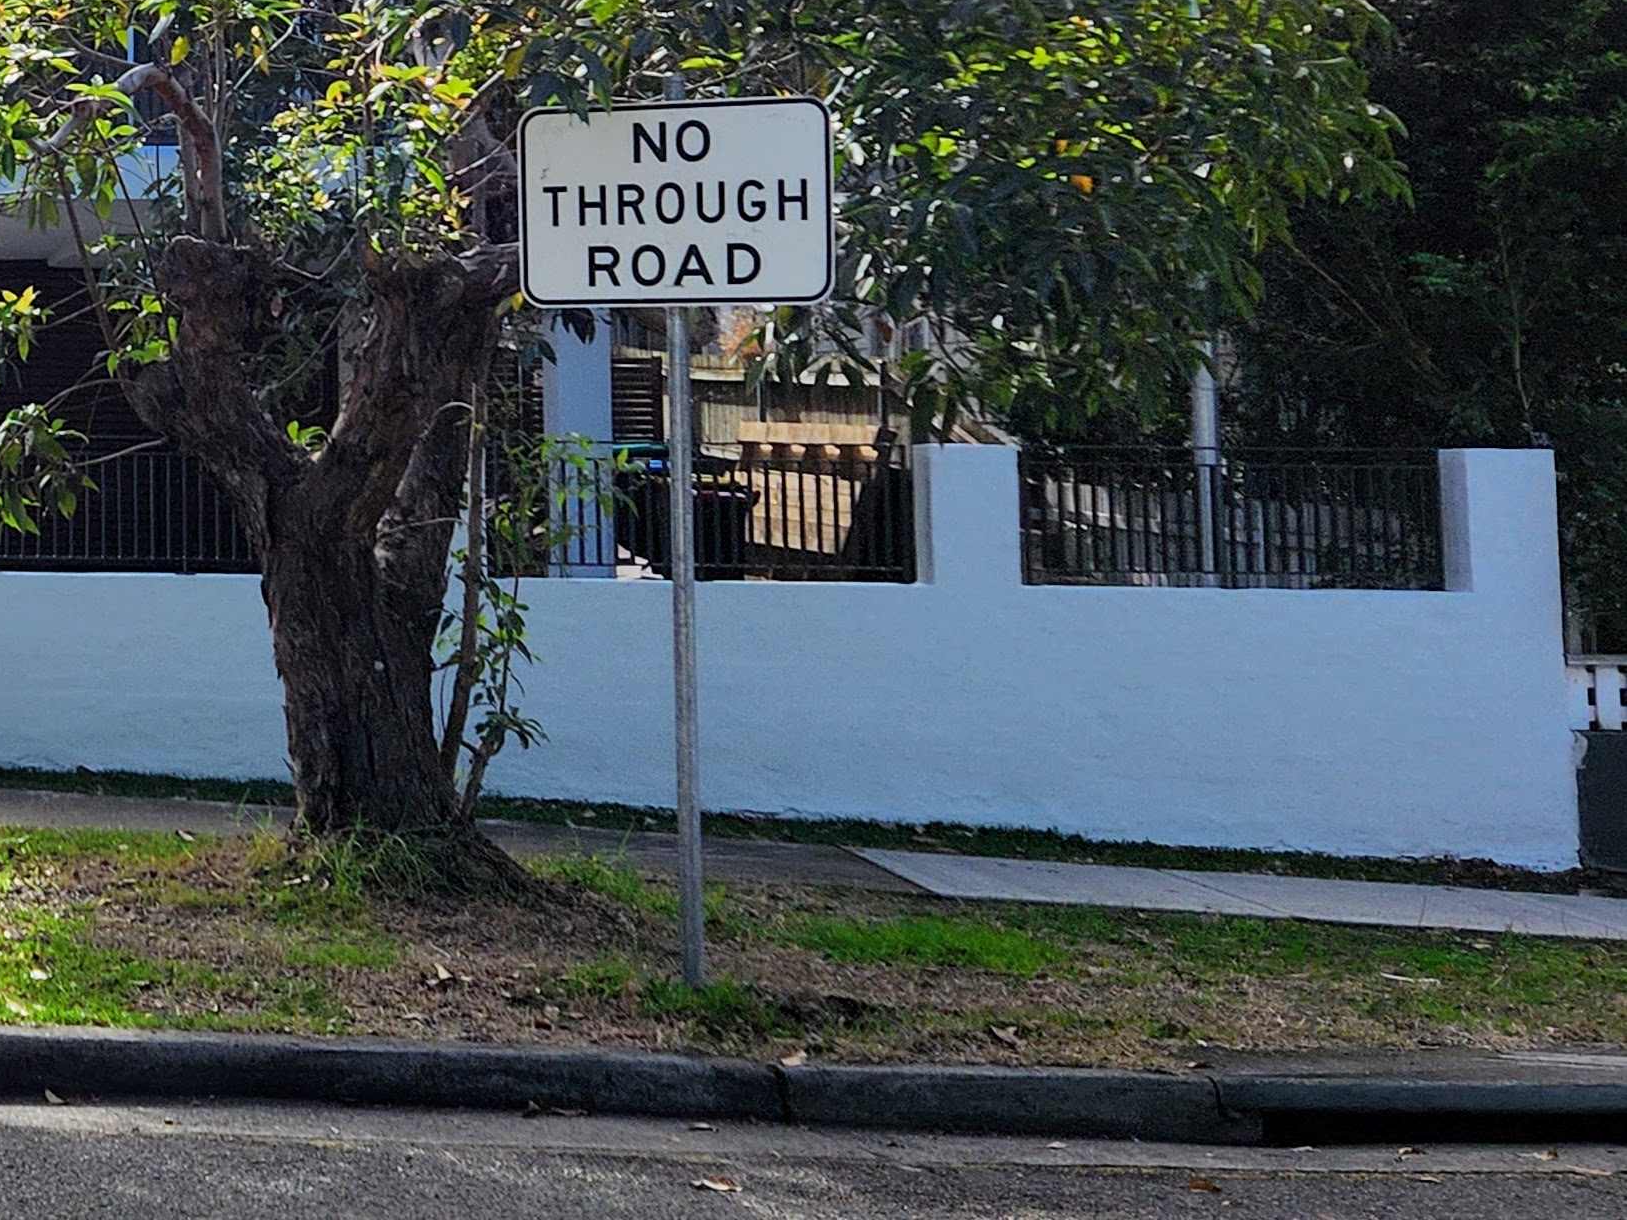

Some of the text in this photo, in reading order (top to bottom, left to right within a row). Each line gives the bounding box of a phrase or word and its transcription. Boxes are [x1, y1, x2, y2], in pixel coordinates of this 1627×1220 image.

[632, 120, 711, 163] NO
[542, 178, 808, 226] THROUGH
[587, 243, 761, 287] ROAD
